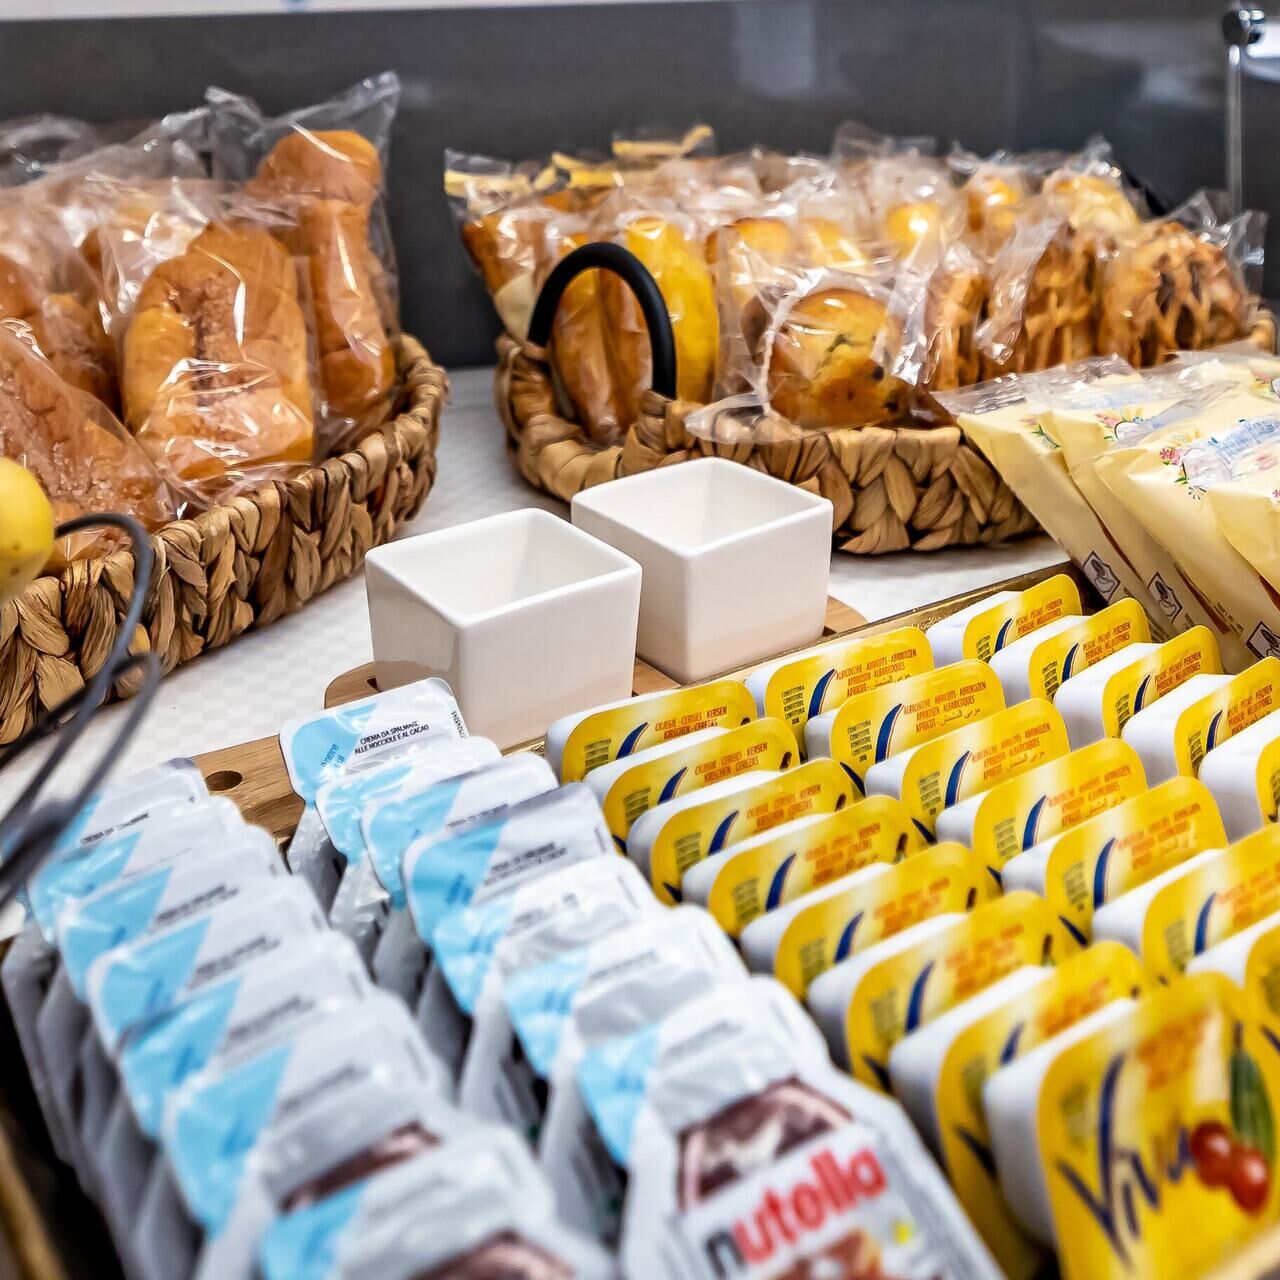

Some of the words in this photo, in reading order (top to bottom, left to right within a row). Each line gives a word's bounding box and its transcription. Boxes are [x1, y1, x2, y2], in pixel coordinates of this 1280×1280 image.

[706, 706, 728, 719] KERSEN
[354, 744, 369, 755] ALLE
[368, 735, 399, 751] NOCCIOLE
[402, 730, 411, 739] AL
[409, 723, 430, 736] CACAO
[360, 733, 382, 745] CREMA
[381, 729, 390, 739] DA
[390, 721, 419, 735] SPALMARE
